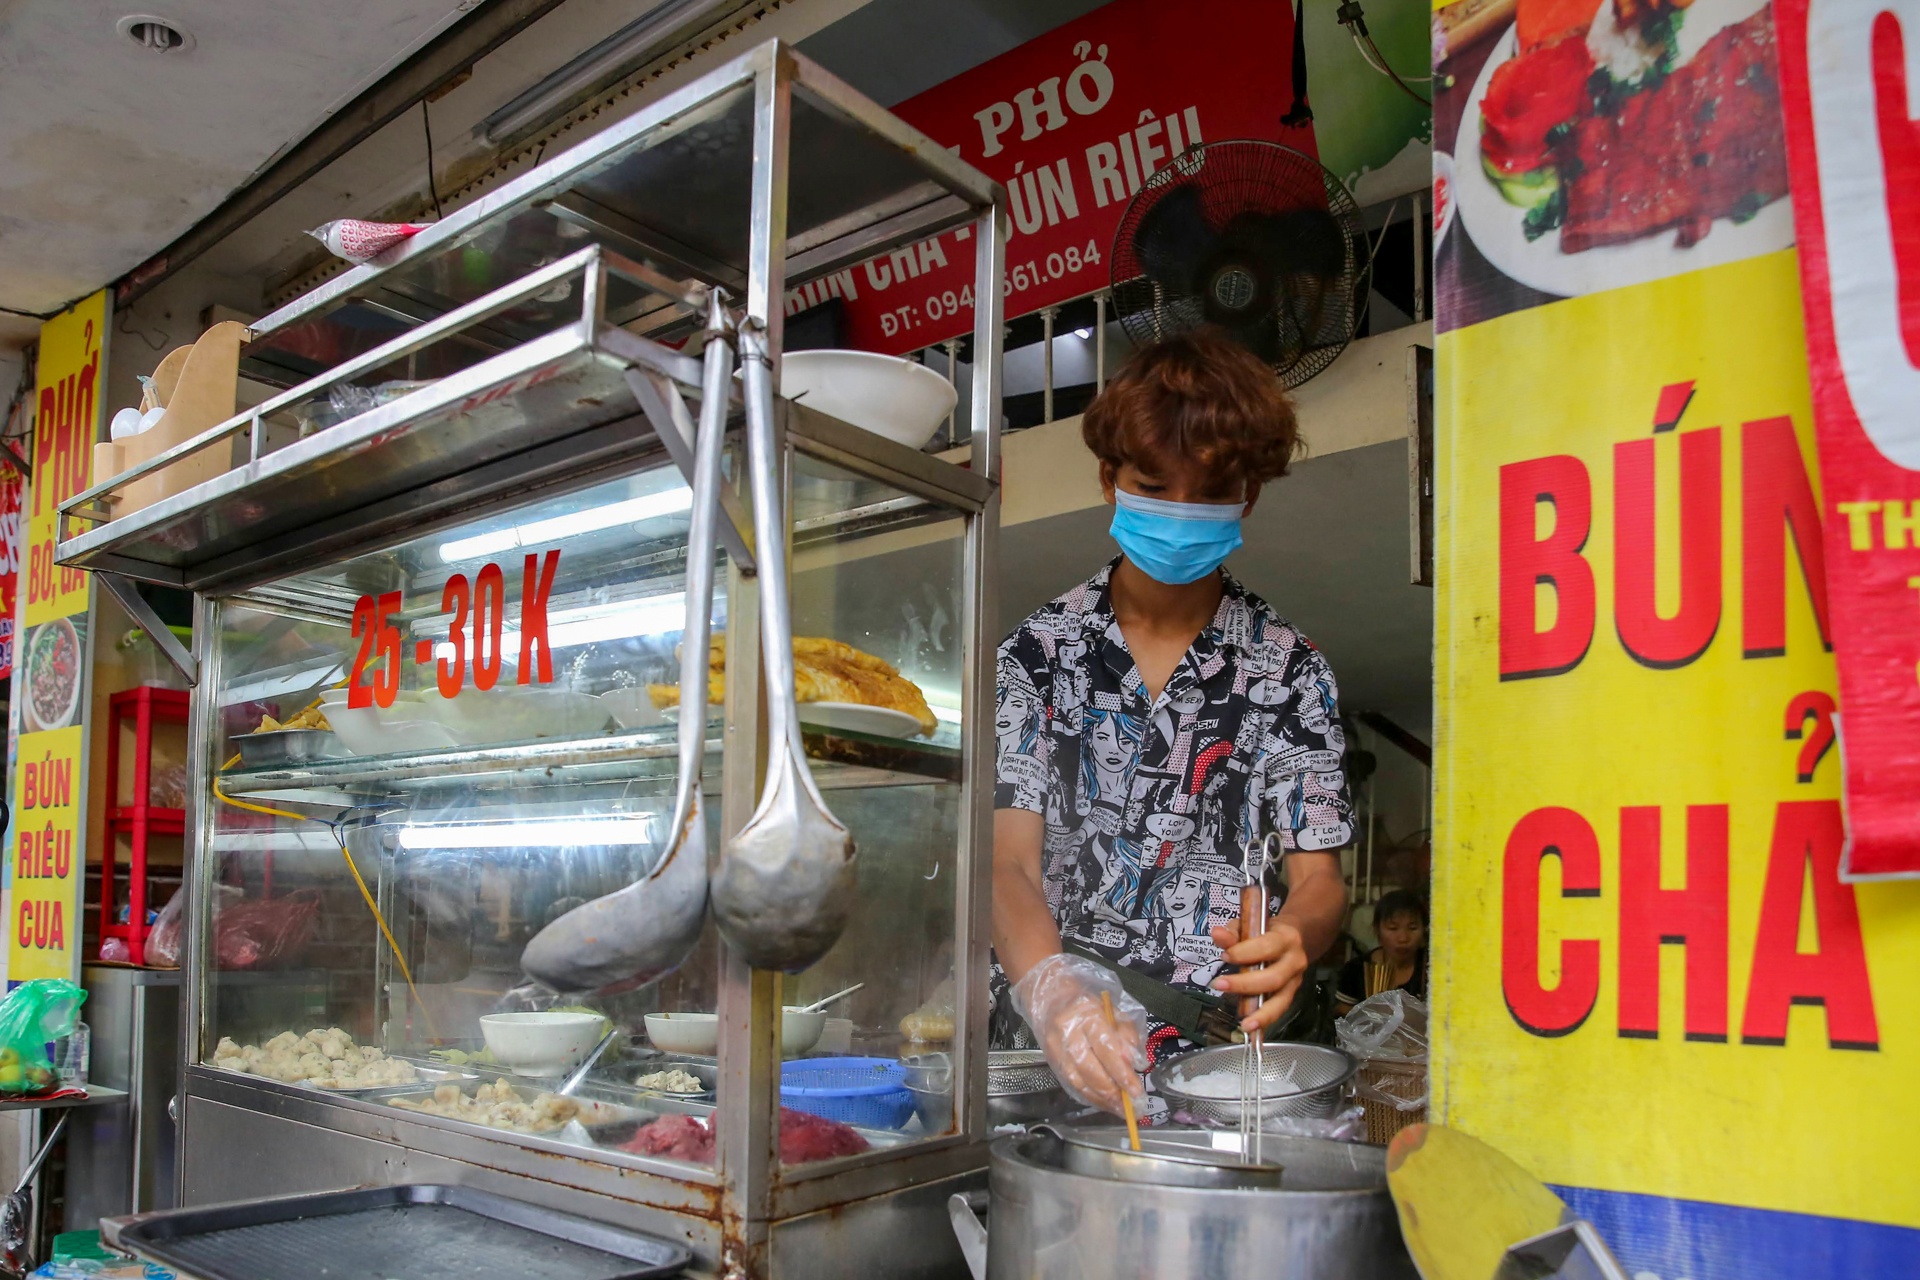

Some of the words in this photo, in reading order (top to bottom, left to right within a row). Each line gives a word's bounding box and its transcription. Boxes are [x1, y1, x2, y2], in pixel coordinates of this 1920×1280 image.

[973, 40, 1114, 158] PHỞ
[1004, 160, 1080, 243] ÚN
[1085, 105, 1206, 208] RIÊU
[880, 305, 921, 338] ĐT:
[34, 319, 98, 517] PHỞ
[1499, 379, 1835, 683] BÚN
[348, 590, 402, 709] 25
[436, 562, 504, 699] 30
[517, 549, 561, 685] K
[23, 750, 72, 809] BÚN
[1322, 825, 1342, 835] LOVE
[18, 820, 71, 879] RIÊU
[1501, 690, 1880, 1052] CHẢ
[18, 900, 64, 950] CUA
